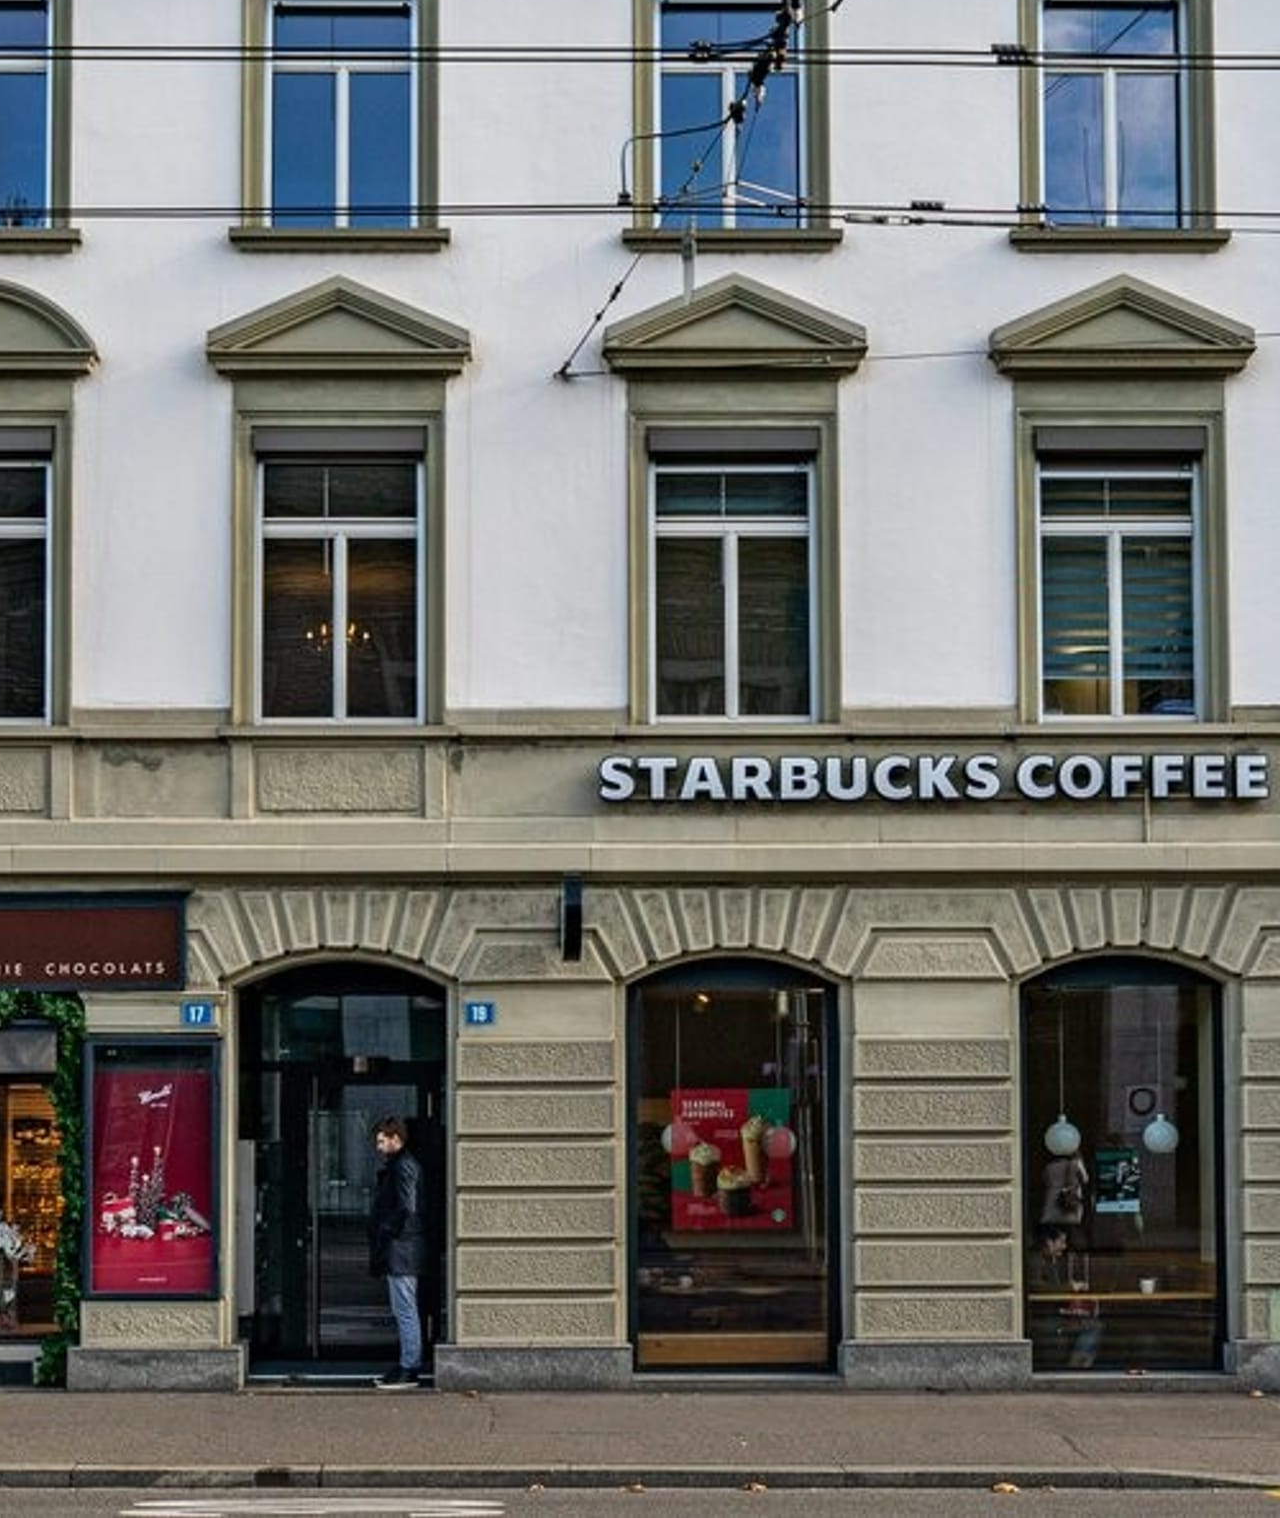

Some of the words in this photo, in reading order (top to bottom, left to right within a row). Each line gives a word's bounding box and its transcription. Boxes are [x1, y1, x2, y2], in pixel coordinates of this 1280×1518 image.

[598, 754, 1000, 801] STARBUCKS
[1016, 753, 1270, 800] COFFEE
[44, 959, 167, 976] CHOCOLATS
[189, 1005, 204, 1024] 17
